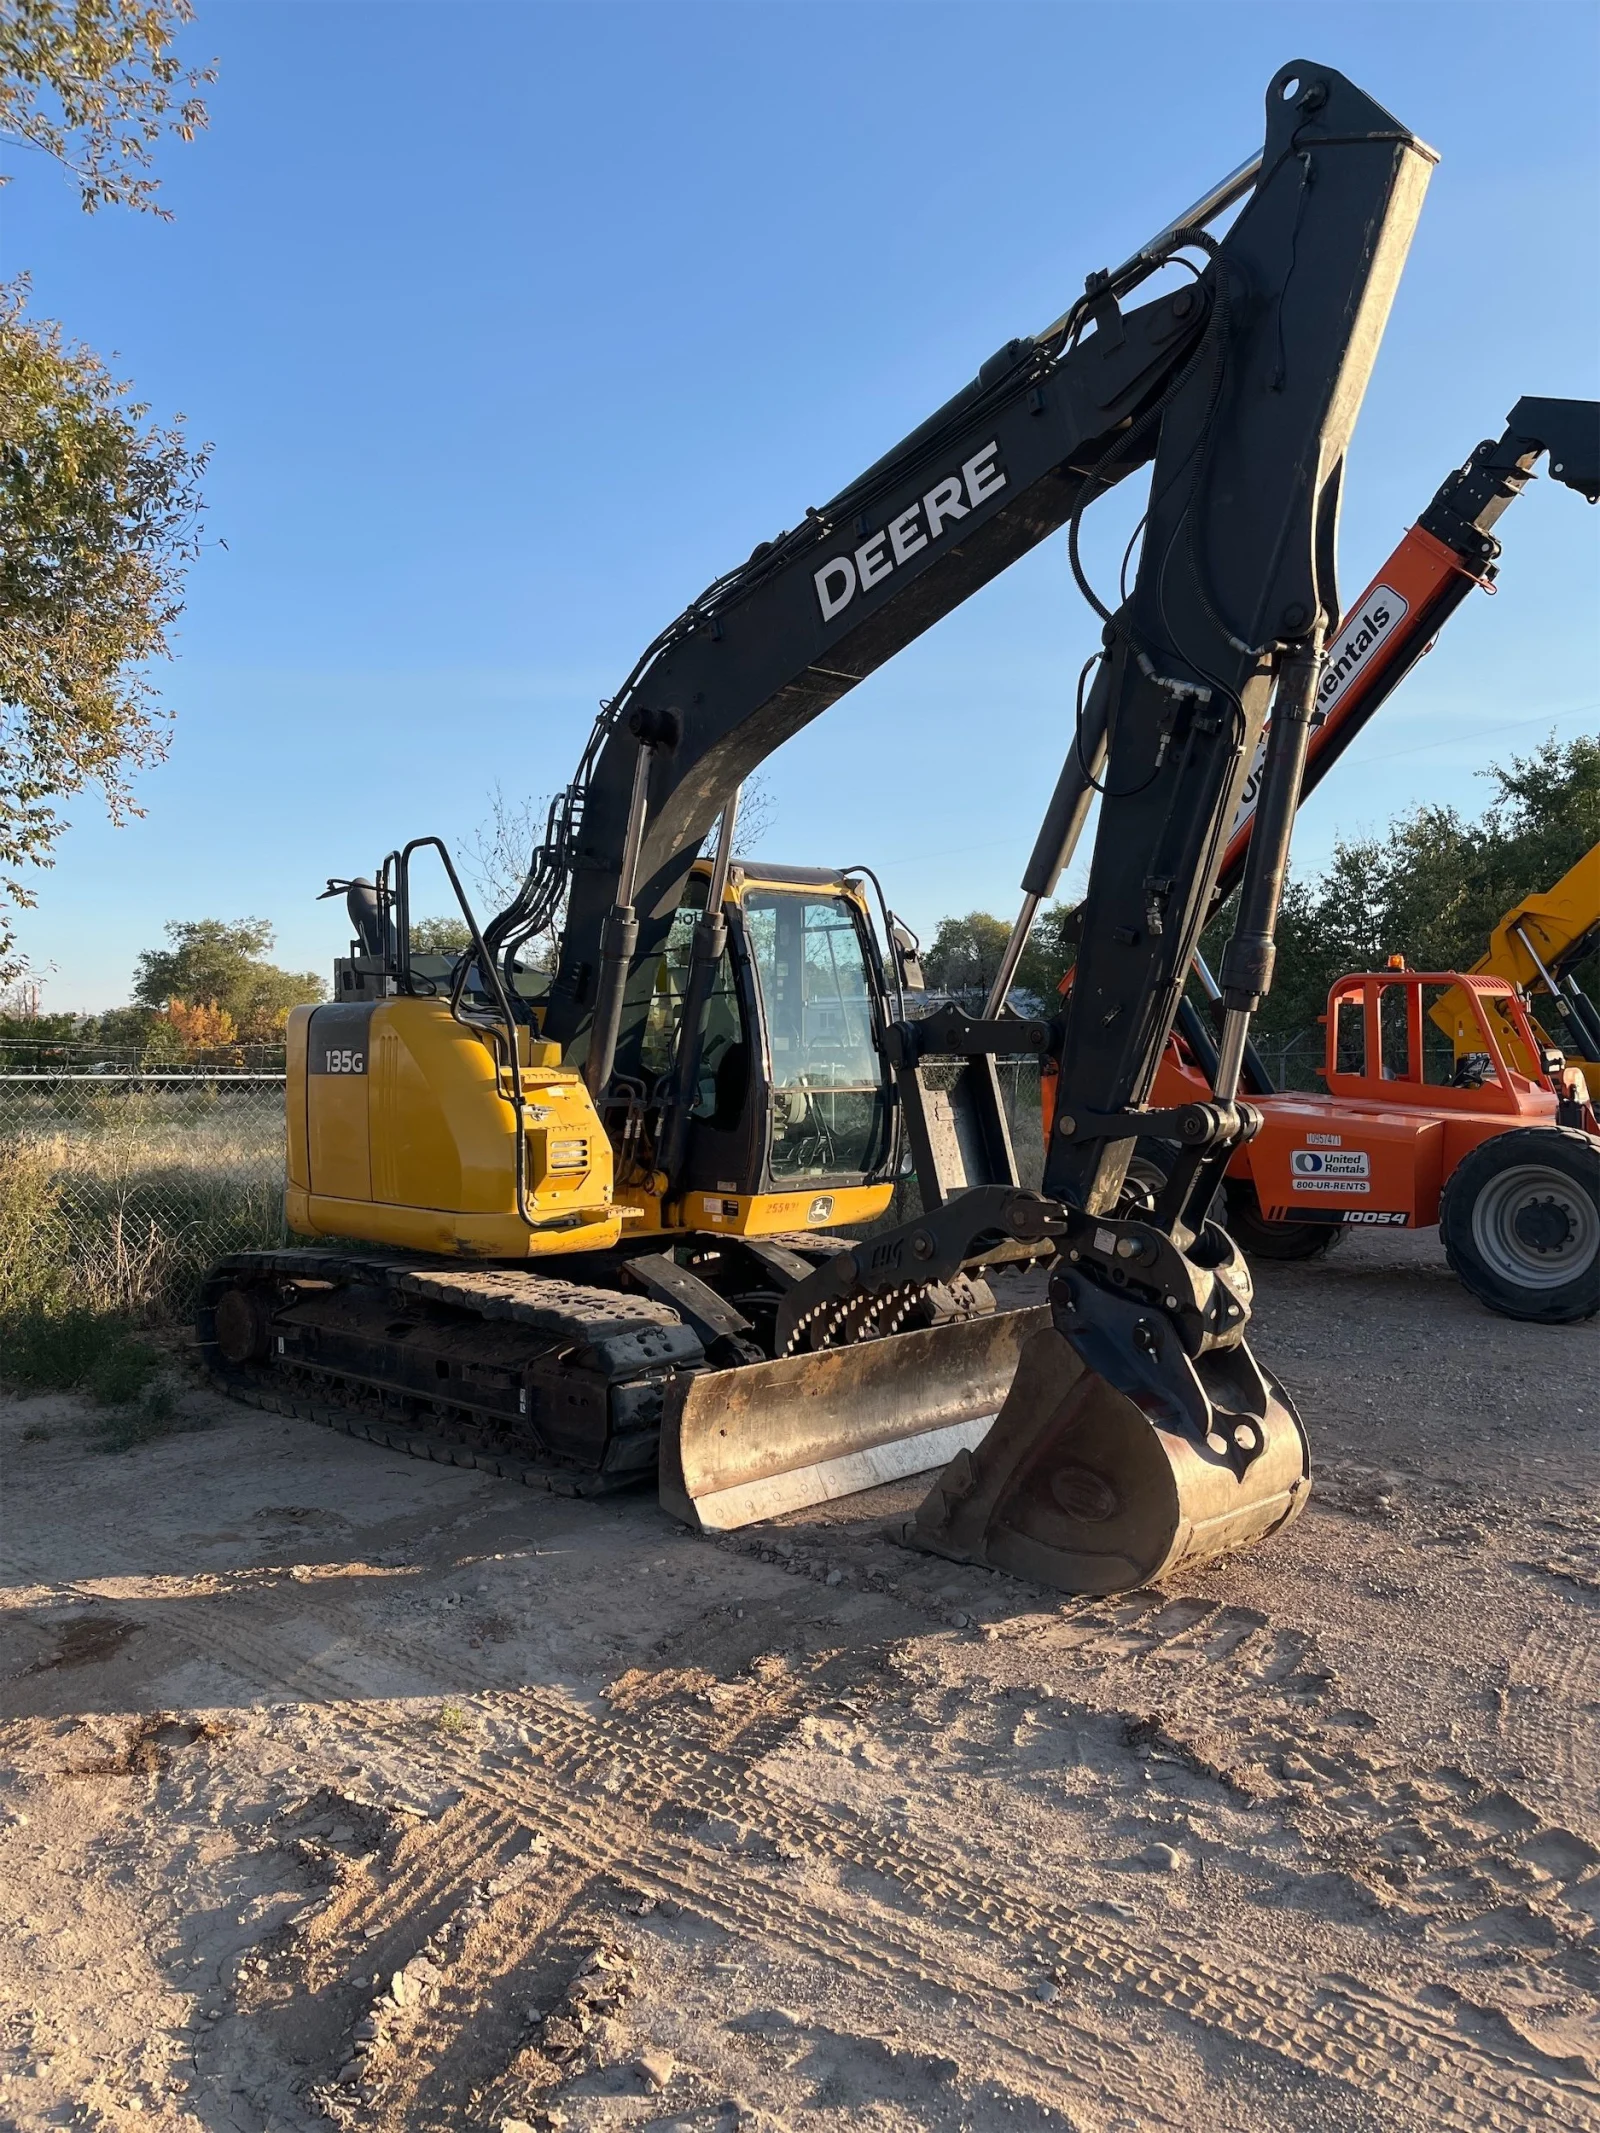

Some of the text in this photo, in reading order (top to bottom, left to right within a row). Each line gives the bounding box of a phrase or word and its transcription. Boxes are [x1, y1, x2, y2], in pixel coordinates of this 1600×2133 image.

[814, 440, 1006, 622] DEERE
[326, 1050, 364, 1073] 135G
[1324, 1154, 1361, 1164] United
[1324, 1163, 1365, 1174] Rentals
[1296, 1181, 1366, 1191] 800-UR-RENTS
[1343, 1211, 1406, 1224] 10054
